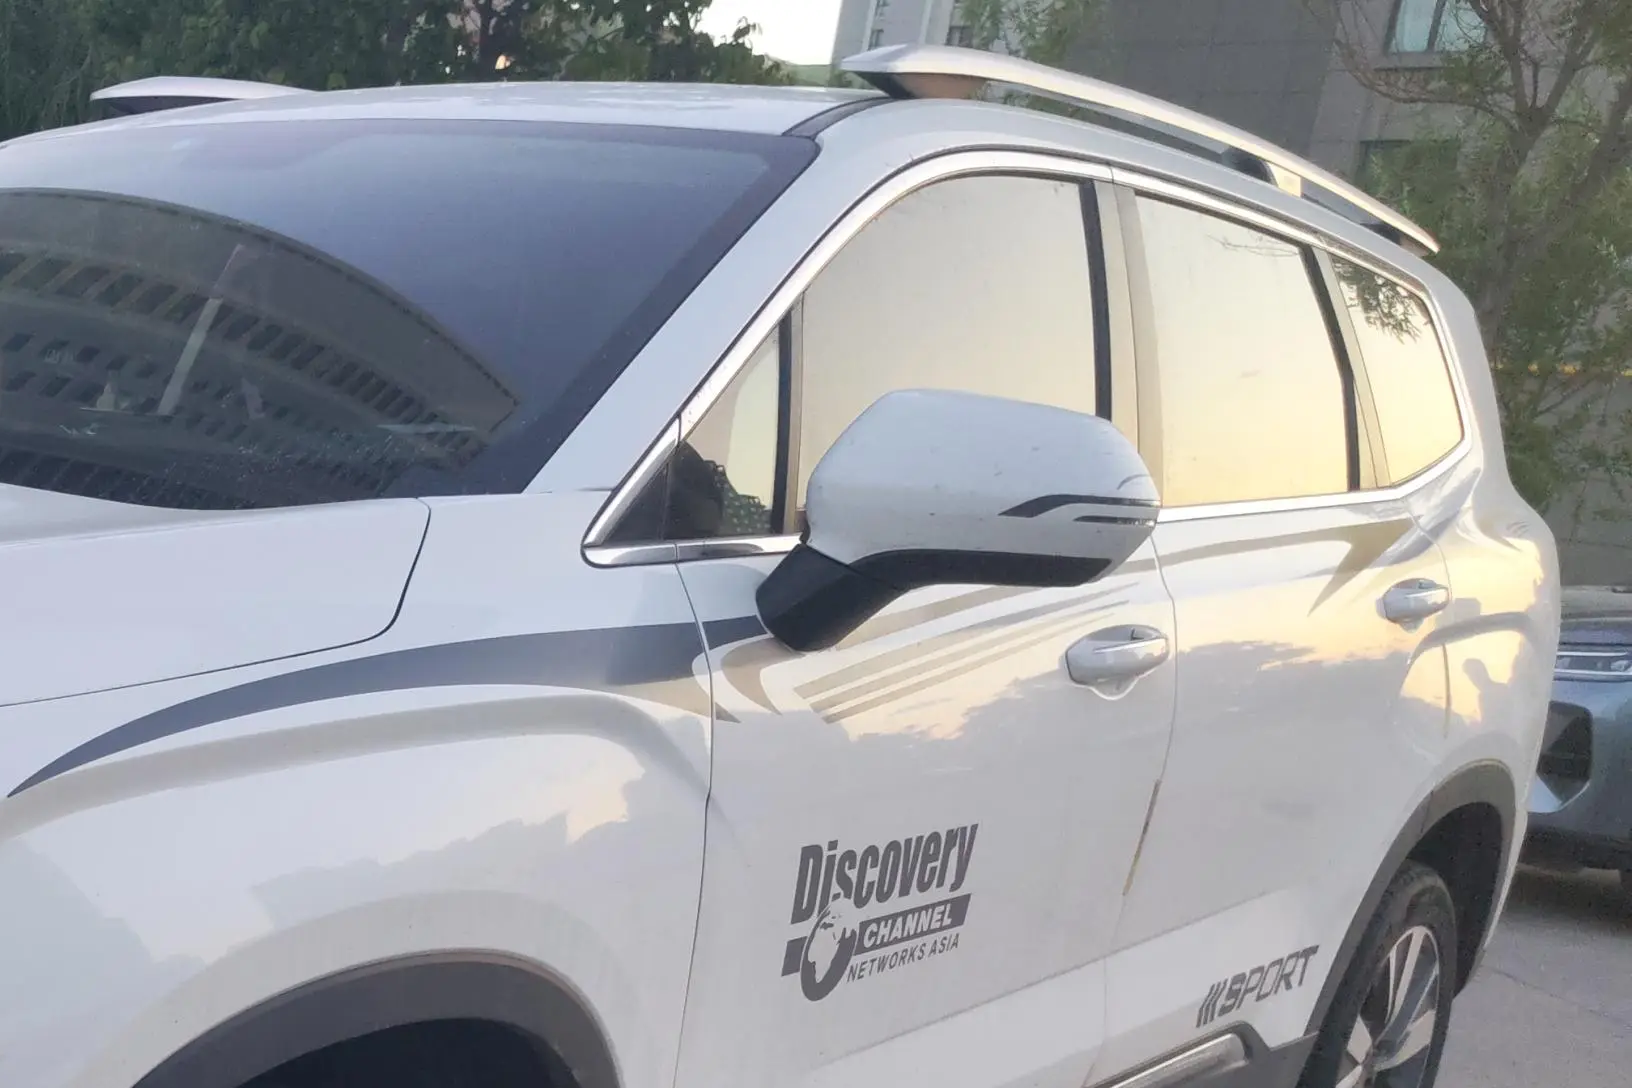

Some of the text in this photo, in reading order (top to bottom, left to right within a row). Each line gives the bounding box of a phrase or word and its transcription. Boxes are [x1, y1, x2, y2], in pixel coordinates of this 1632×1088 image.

[790, 823, 979, 925] Discovery
[862, 902, 953, 949] CHANNEL
[846, 932, 960, 984] NETWORKS ASIA
[1218, 944, 1320, 1018] SPORT
